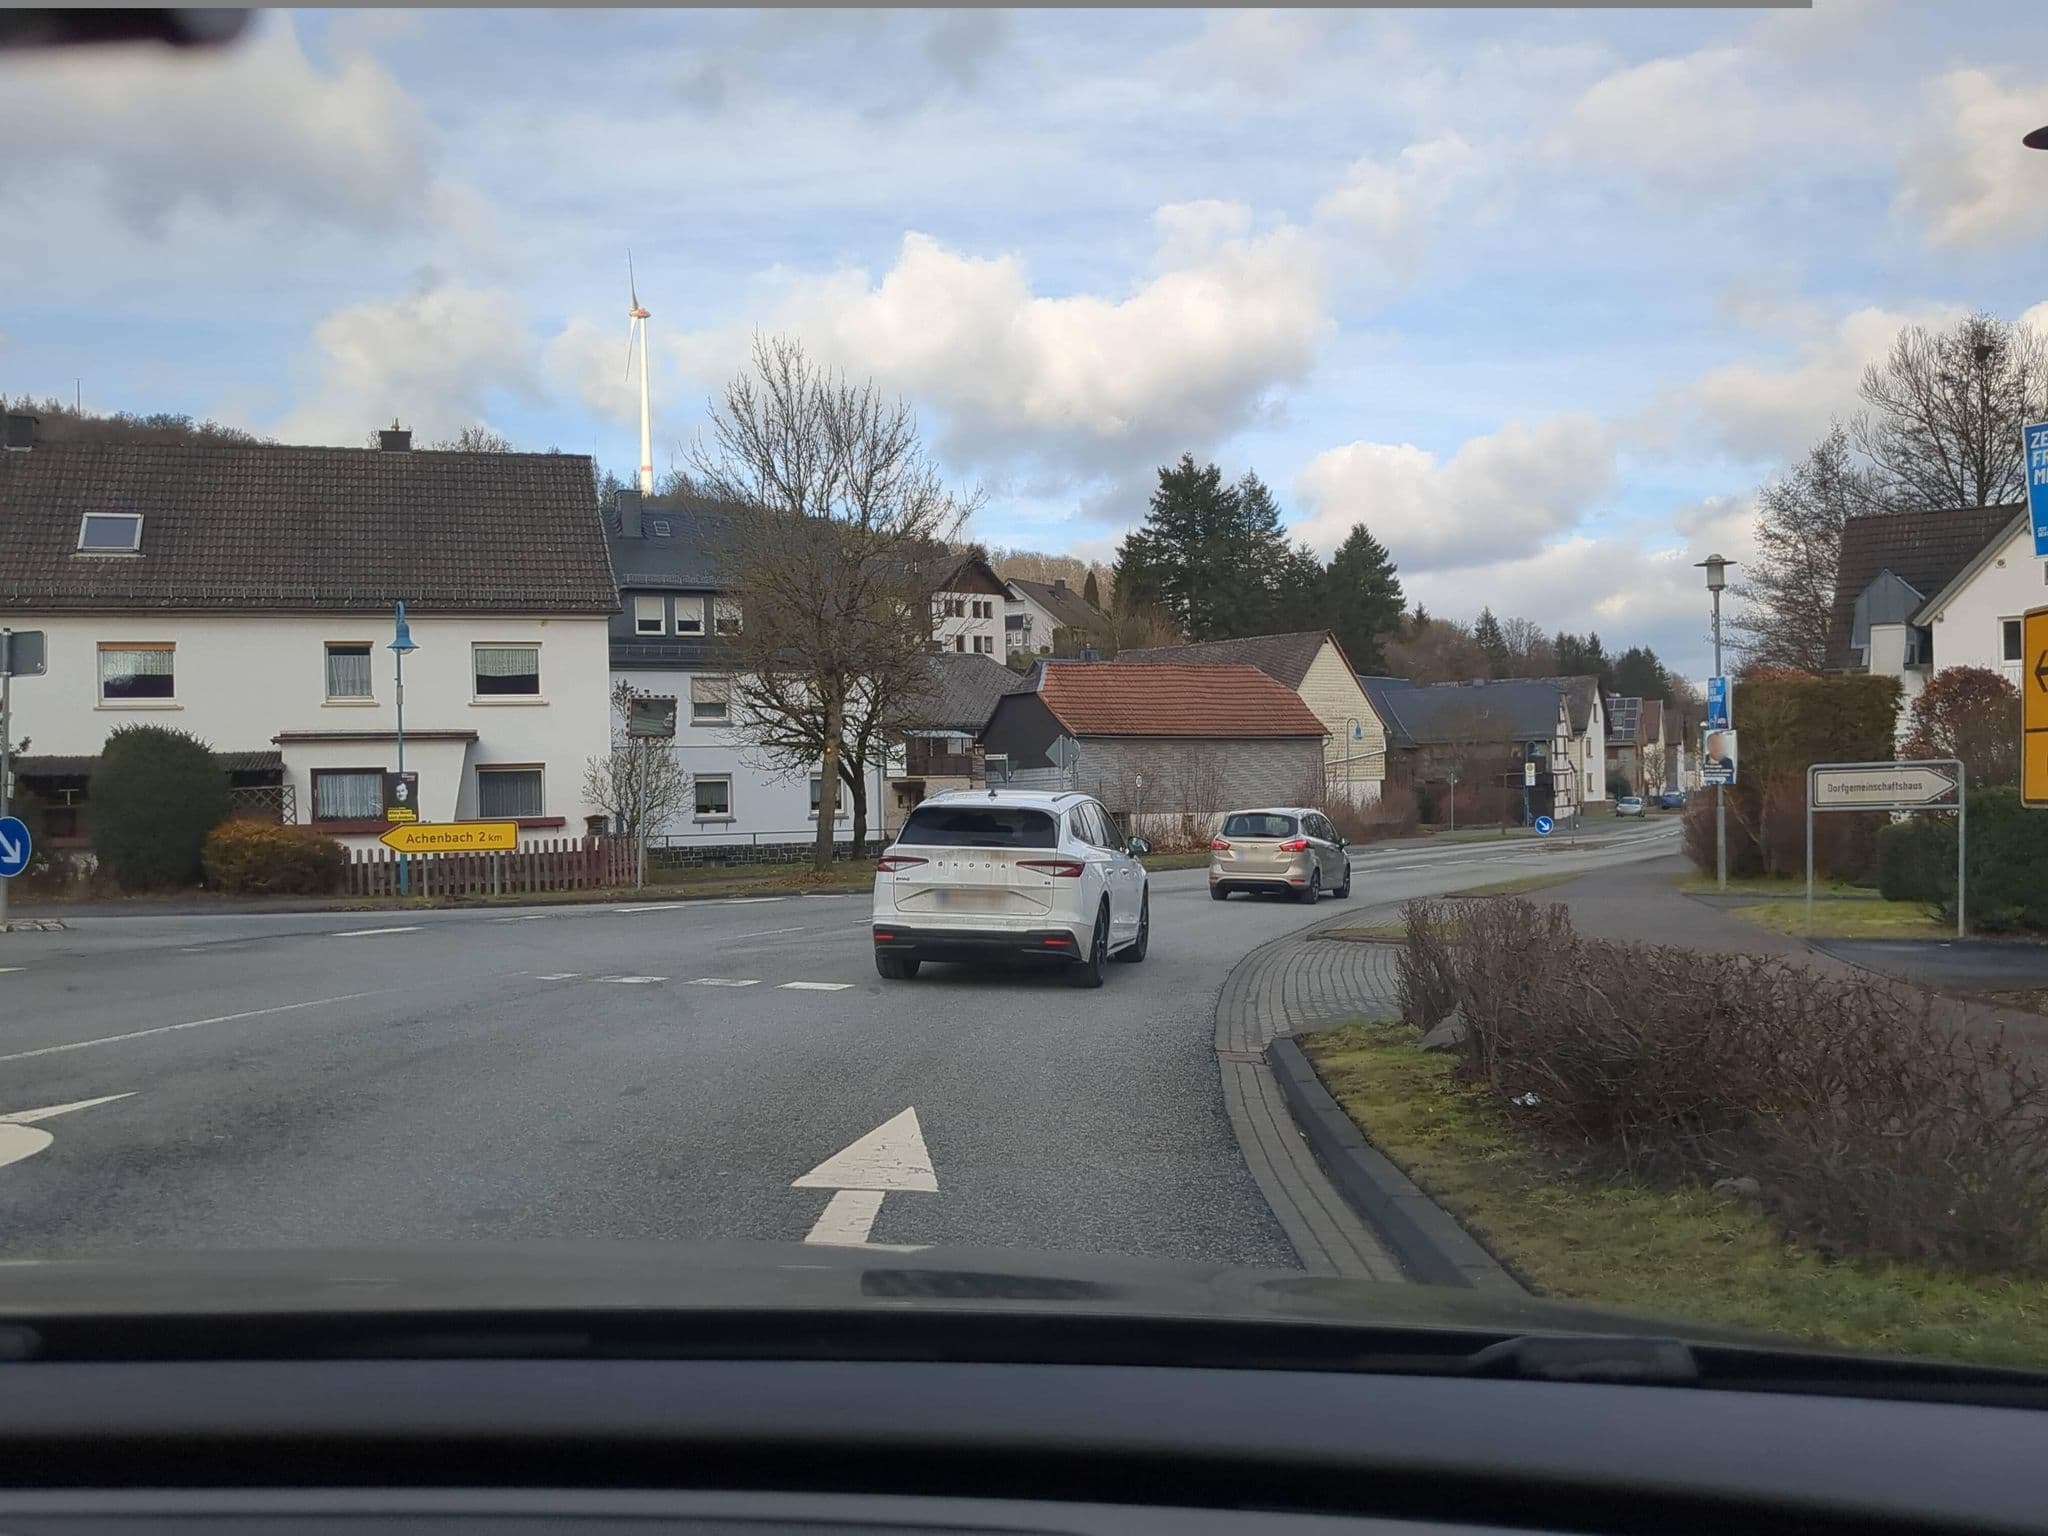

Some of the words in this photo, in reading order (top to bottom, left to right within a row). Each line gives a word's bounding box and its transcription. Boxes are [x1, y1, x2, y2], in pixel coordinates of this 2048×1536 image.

[1827, 782, 1923, 794] Dorfgemeinschaftshaus
[406, 833, 473, 844] Achenbach
[478, 832, 486, 842] 2
[488, 833, 502, 842] km
